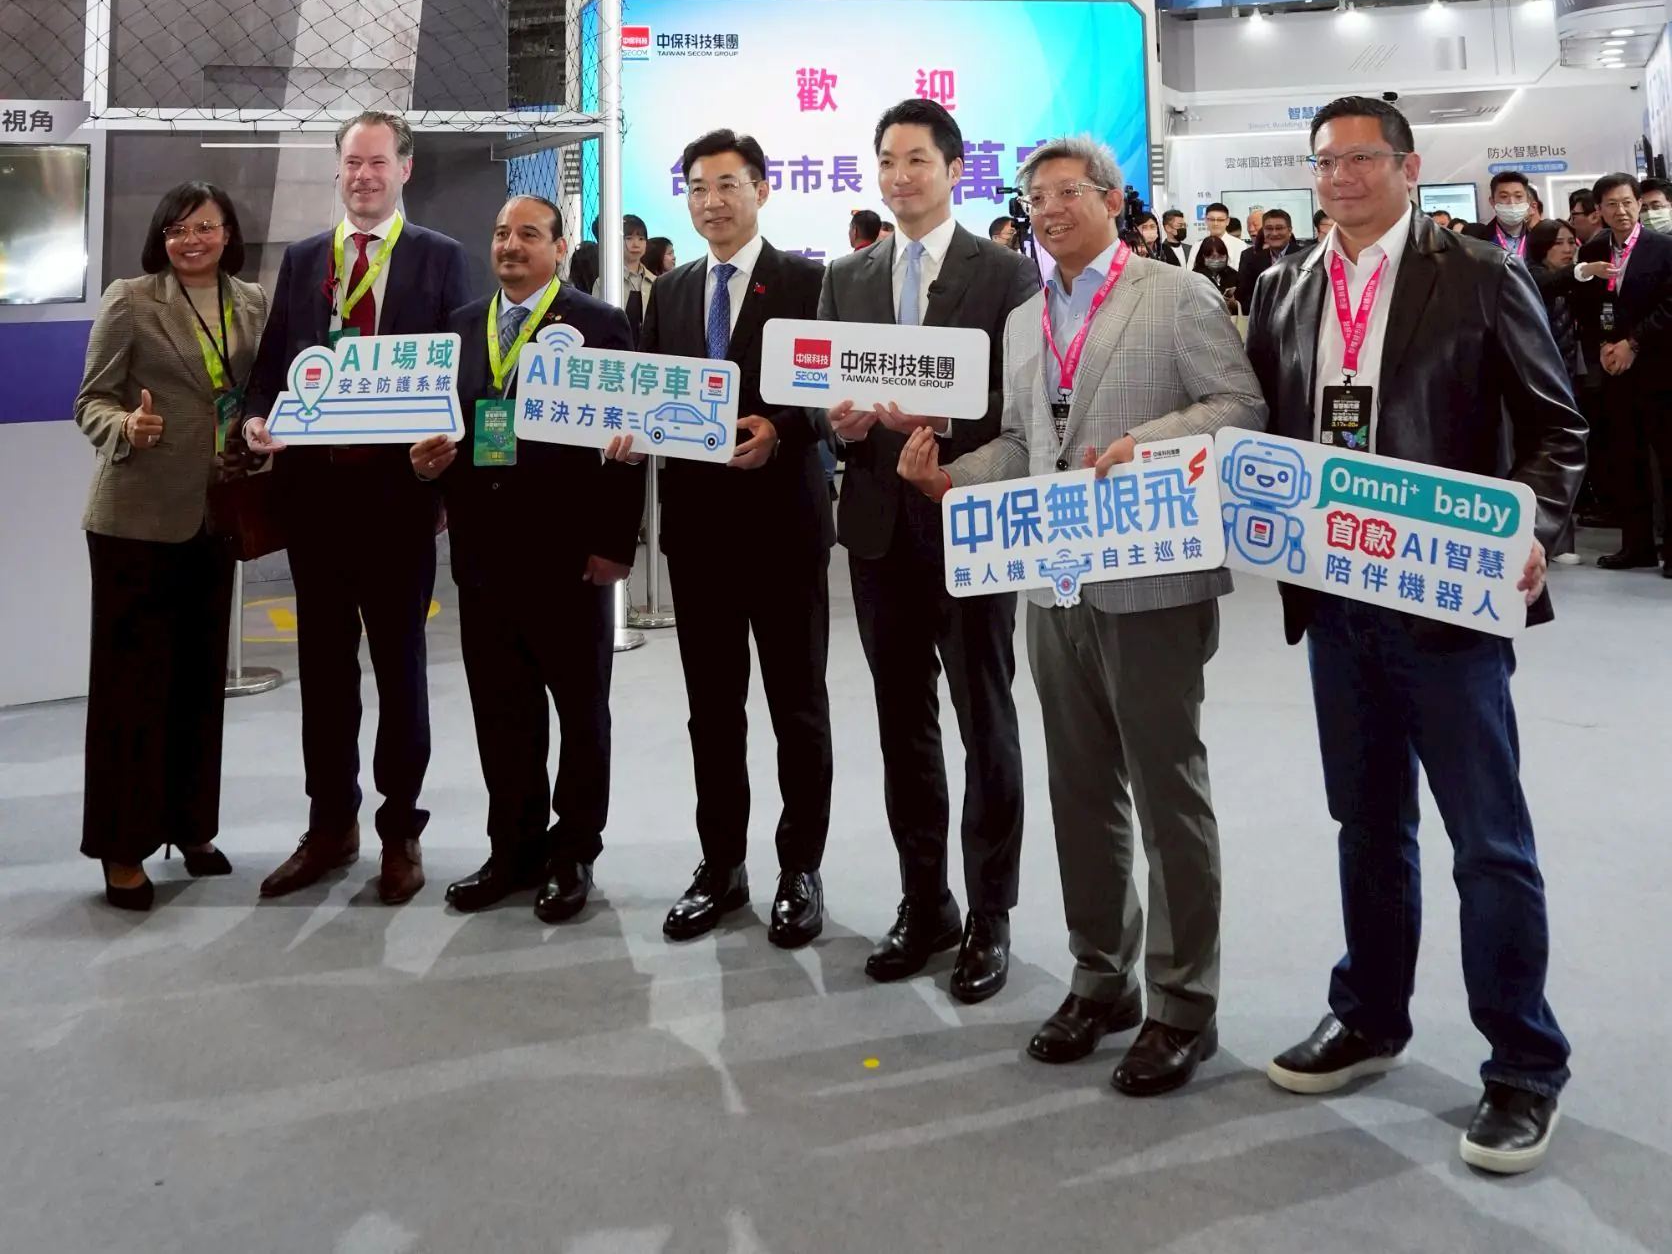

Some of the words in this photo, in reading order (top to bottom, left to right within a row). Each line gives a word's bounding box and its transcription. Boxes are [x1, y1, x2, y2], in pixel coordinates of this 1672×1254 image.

[657, 33, 739, 49] 中保科技集團
[1288, 106, 1324, 120] 智慧
[1488, 145, 1566, 159] 防火智慧Plus
[795, 354, 829, 365] 中保科技
[841, 350, 954, 380] 中保科技集團
[338, 375, 451, 394] 安全防護系統
[526, 354, 691, 399] AI智慧停車
[795, 371, 828, 381] SECOM
[841, 374, 879, 384] TAIWAN
[881, 377, 916, 386] SECOM
[919, 380, 954, 388] GROUP
[524, 398, 624, 430] 解決方案
[950, 462, 1202, 554] 中保無限飛
[1434, 486, 1511, 532] baby
[954, 560, 1025, 587] 無人機
[1102, 537, 1203, 569] 自主巡檢
[1325, 554, 1500, 621] 陪伴機器人
